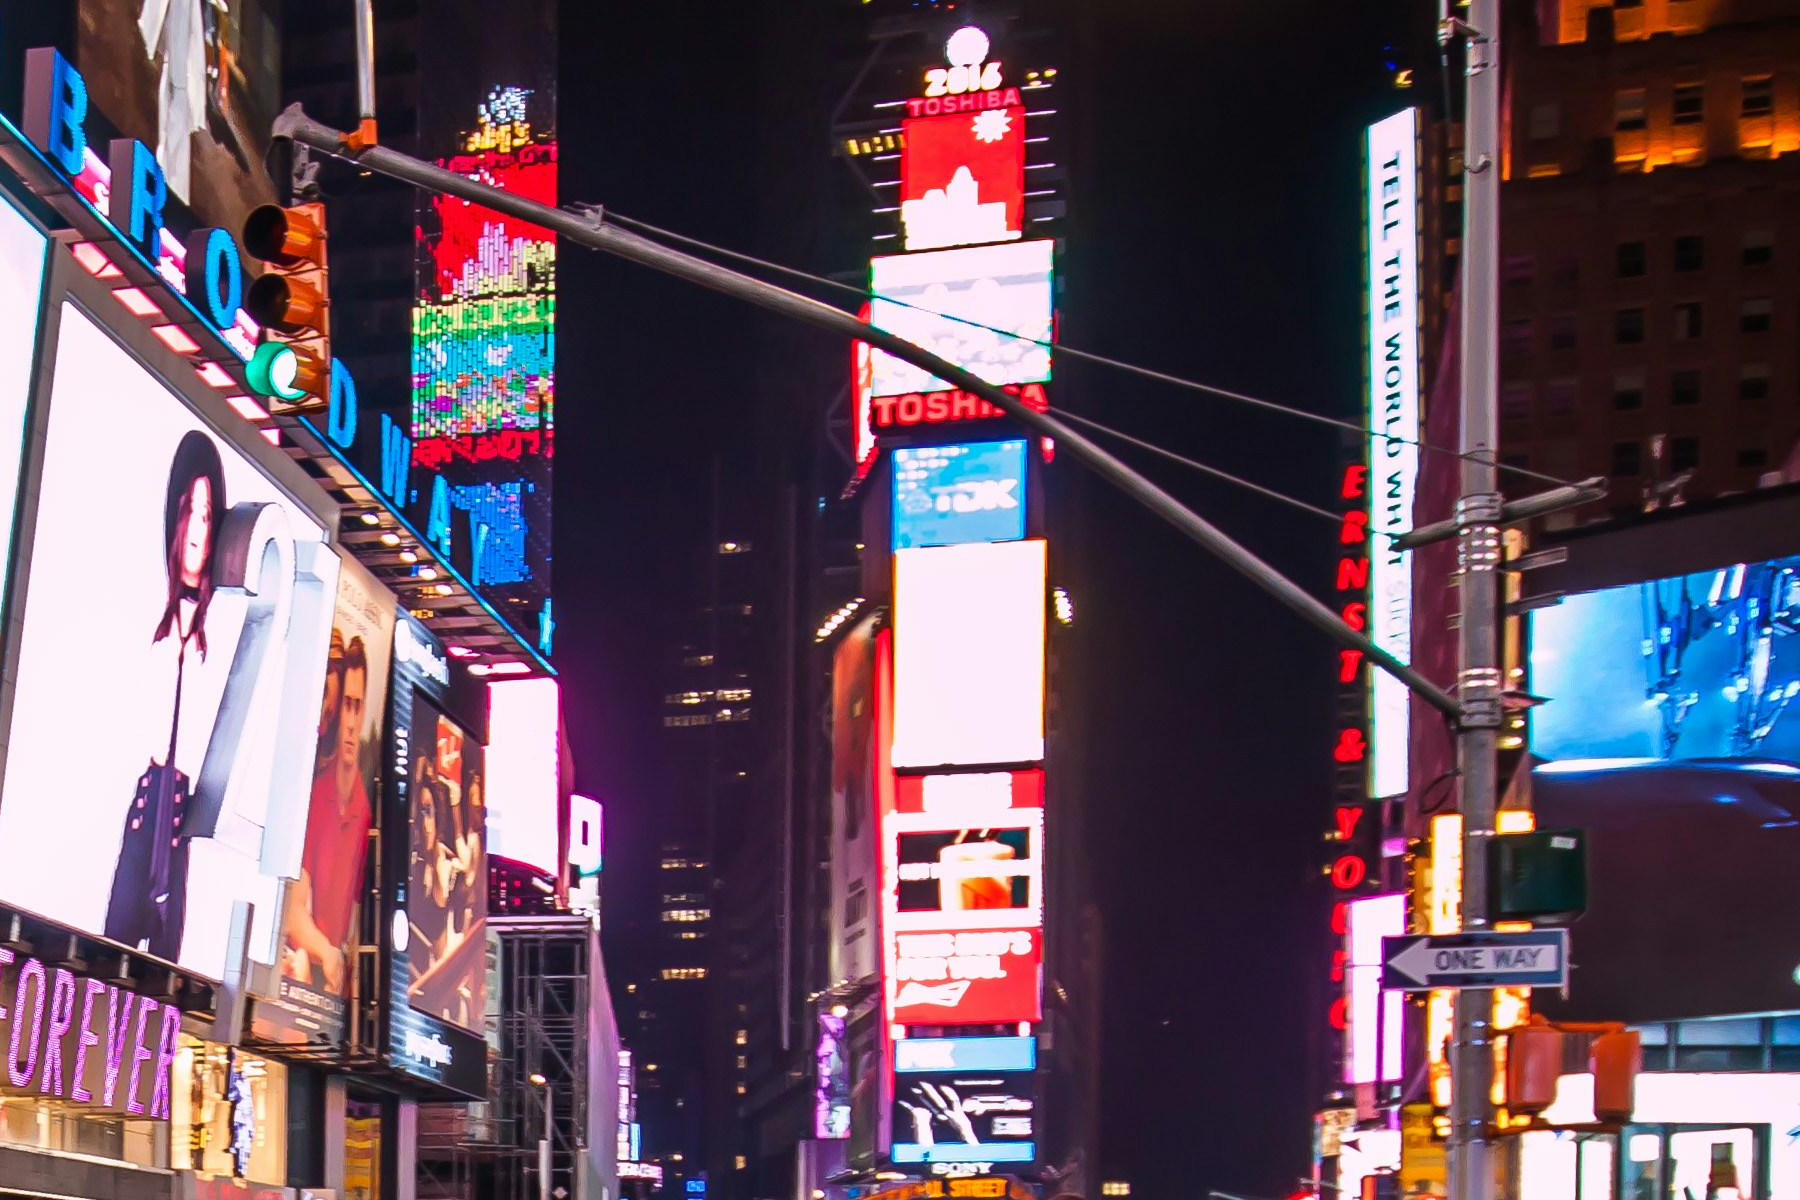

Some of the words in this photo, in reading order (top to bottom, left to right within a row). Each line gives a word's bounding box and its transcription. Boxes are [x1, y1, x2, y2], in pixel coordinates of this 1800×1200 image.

[908, 88, 1022, 118] TOSHIBA
[924, 61, 1003, 97] 2016
[1381, 151, 1401, 242] TELL
[47, 46, 491, 588] BRODWAY
[1382, 250, 1402, 323] THE
[870, 383, 1050, 427] TOSHIA
[1383, 332, 1403, 458] WORLD
[1336, 464, 1369, 684] ERNST
[1435, 950, 1485, 971] ONE
[1493, 948, 1542, 969] WAY
